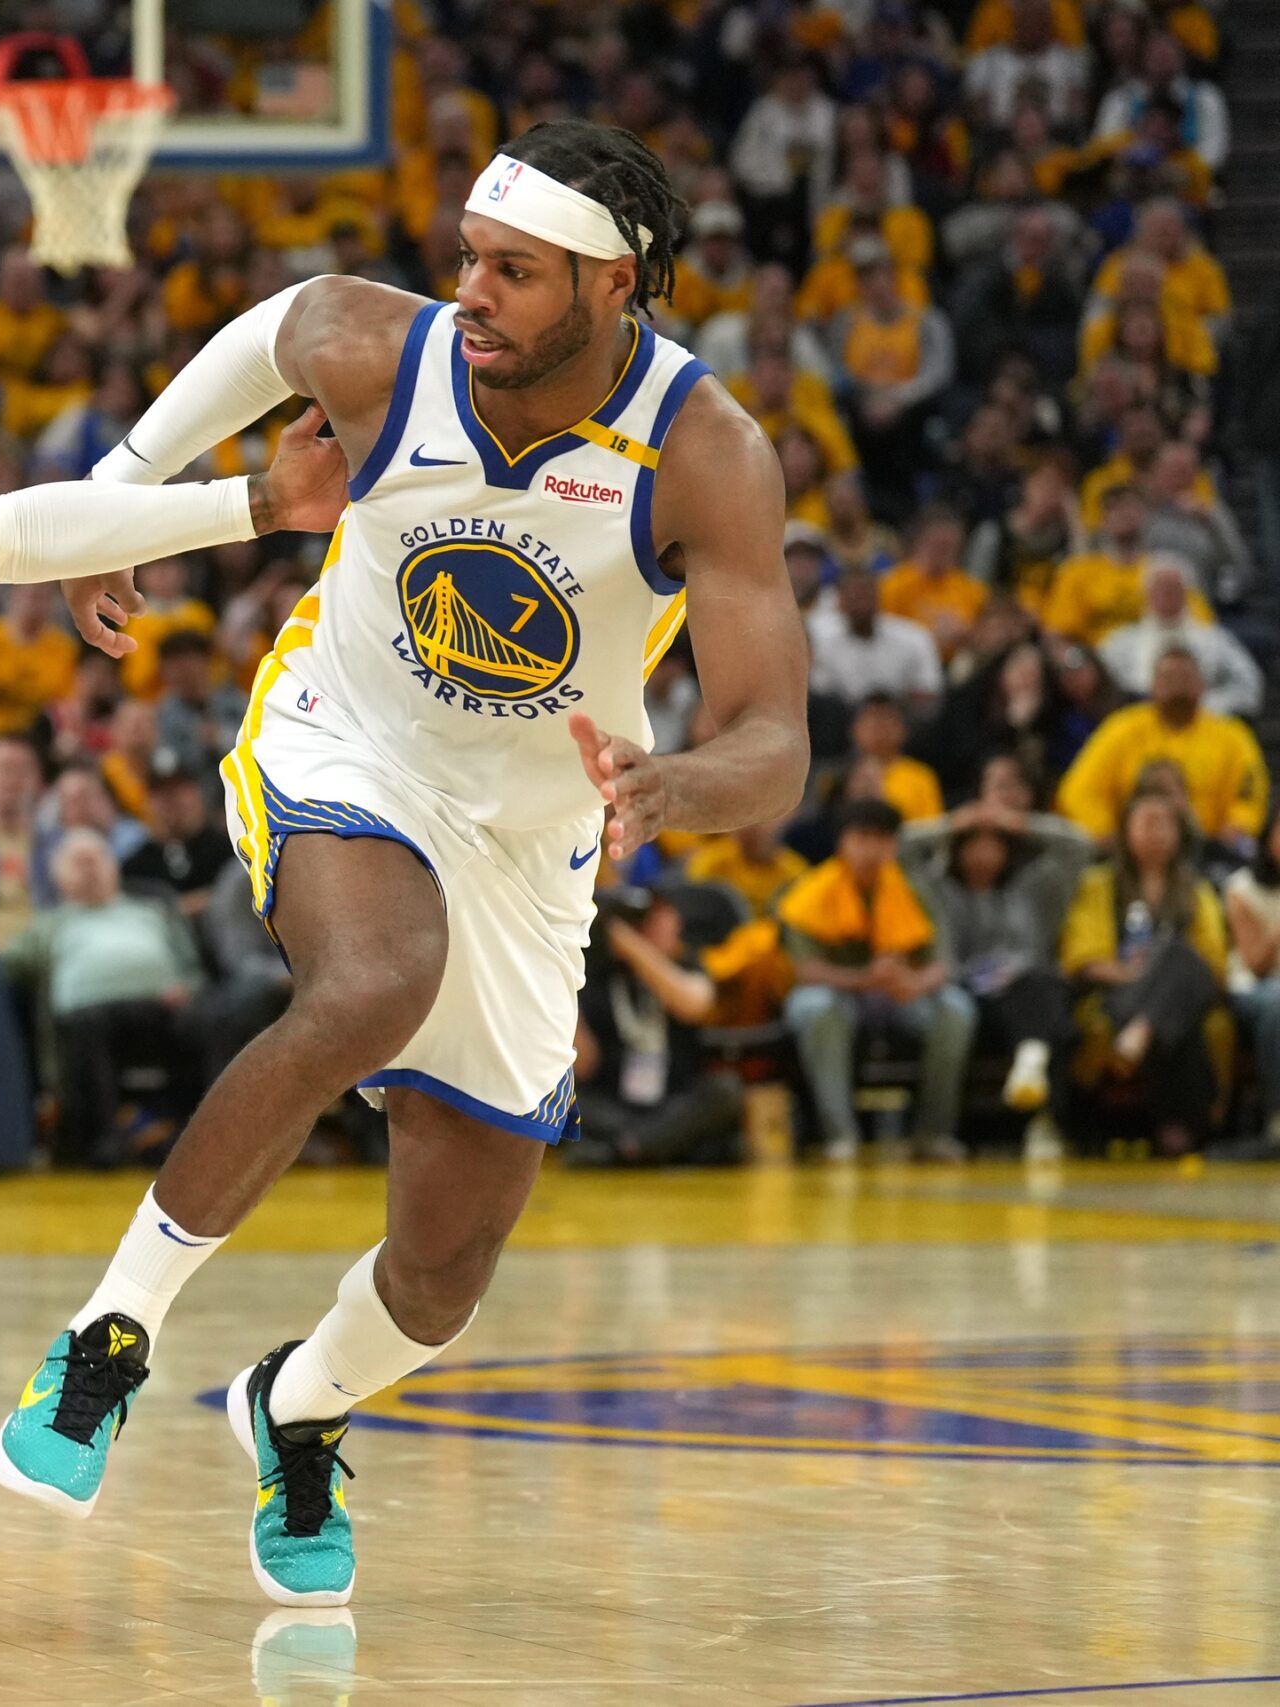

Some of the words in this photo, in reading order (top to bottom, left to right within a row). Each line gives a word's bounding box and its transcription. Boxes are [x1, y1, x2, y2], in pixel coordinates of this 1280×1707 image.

[609, 435, 629, 453] 16
[543, 475, 623, 504] Rakuten
[400, 518, 505, 548] GOLDEN
[517, 533, 584, 599] STATE
[509, 593, 539, 633] 7
[391, 632, 584, 720] WARRIORS
